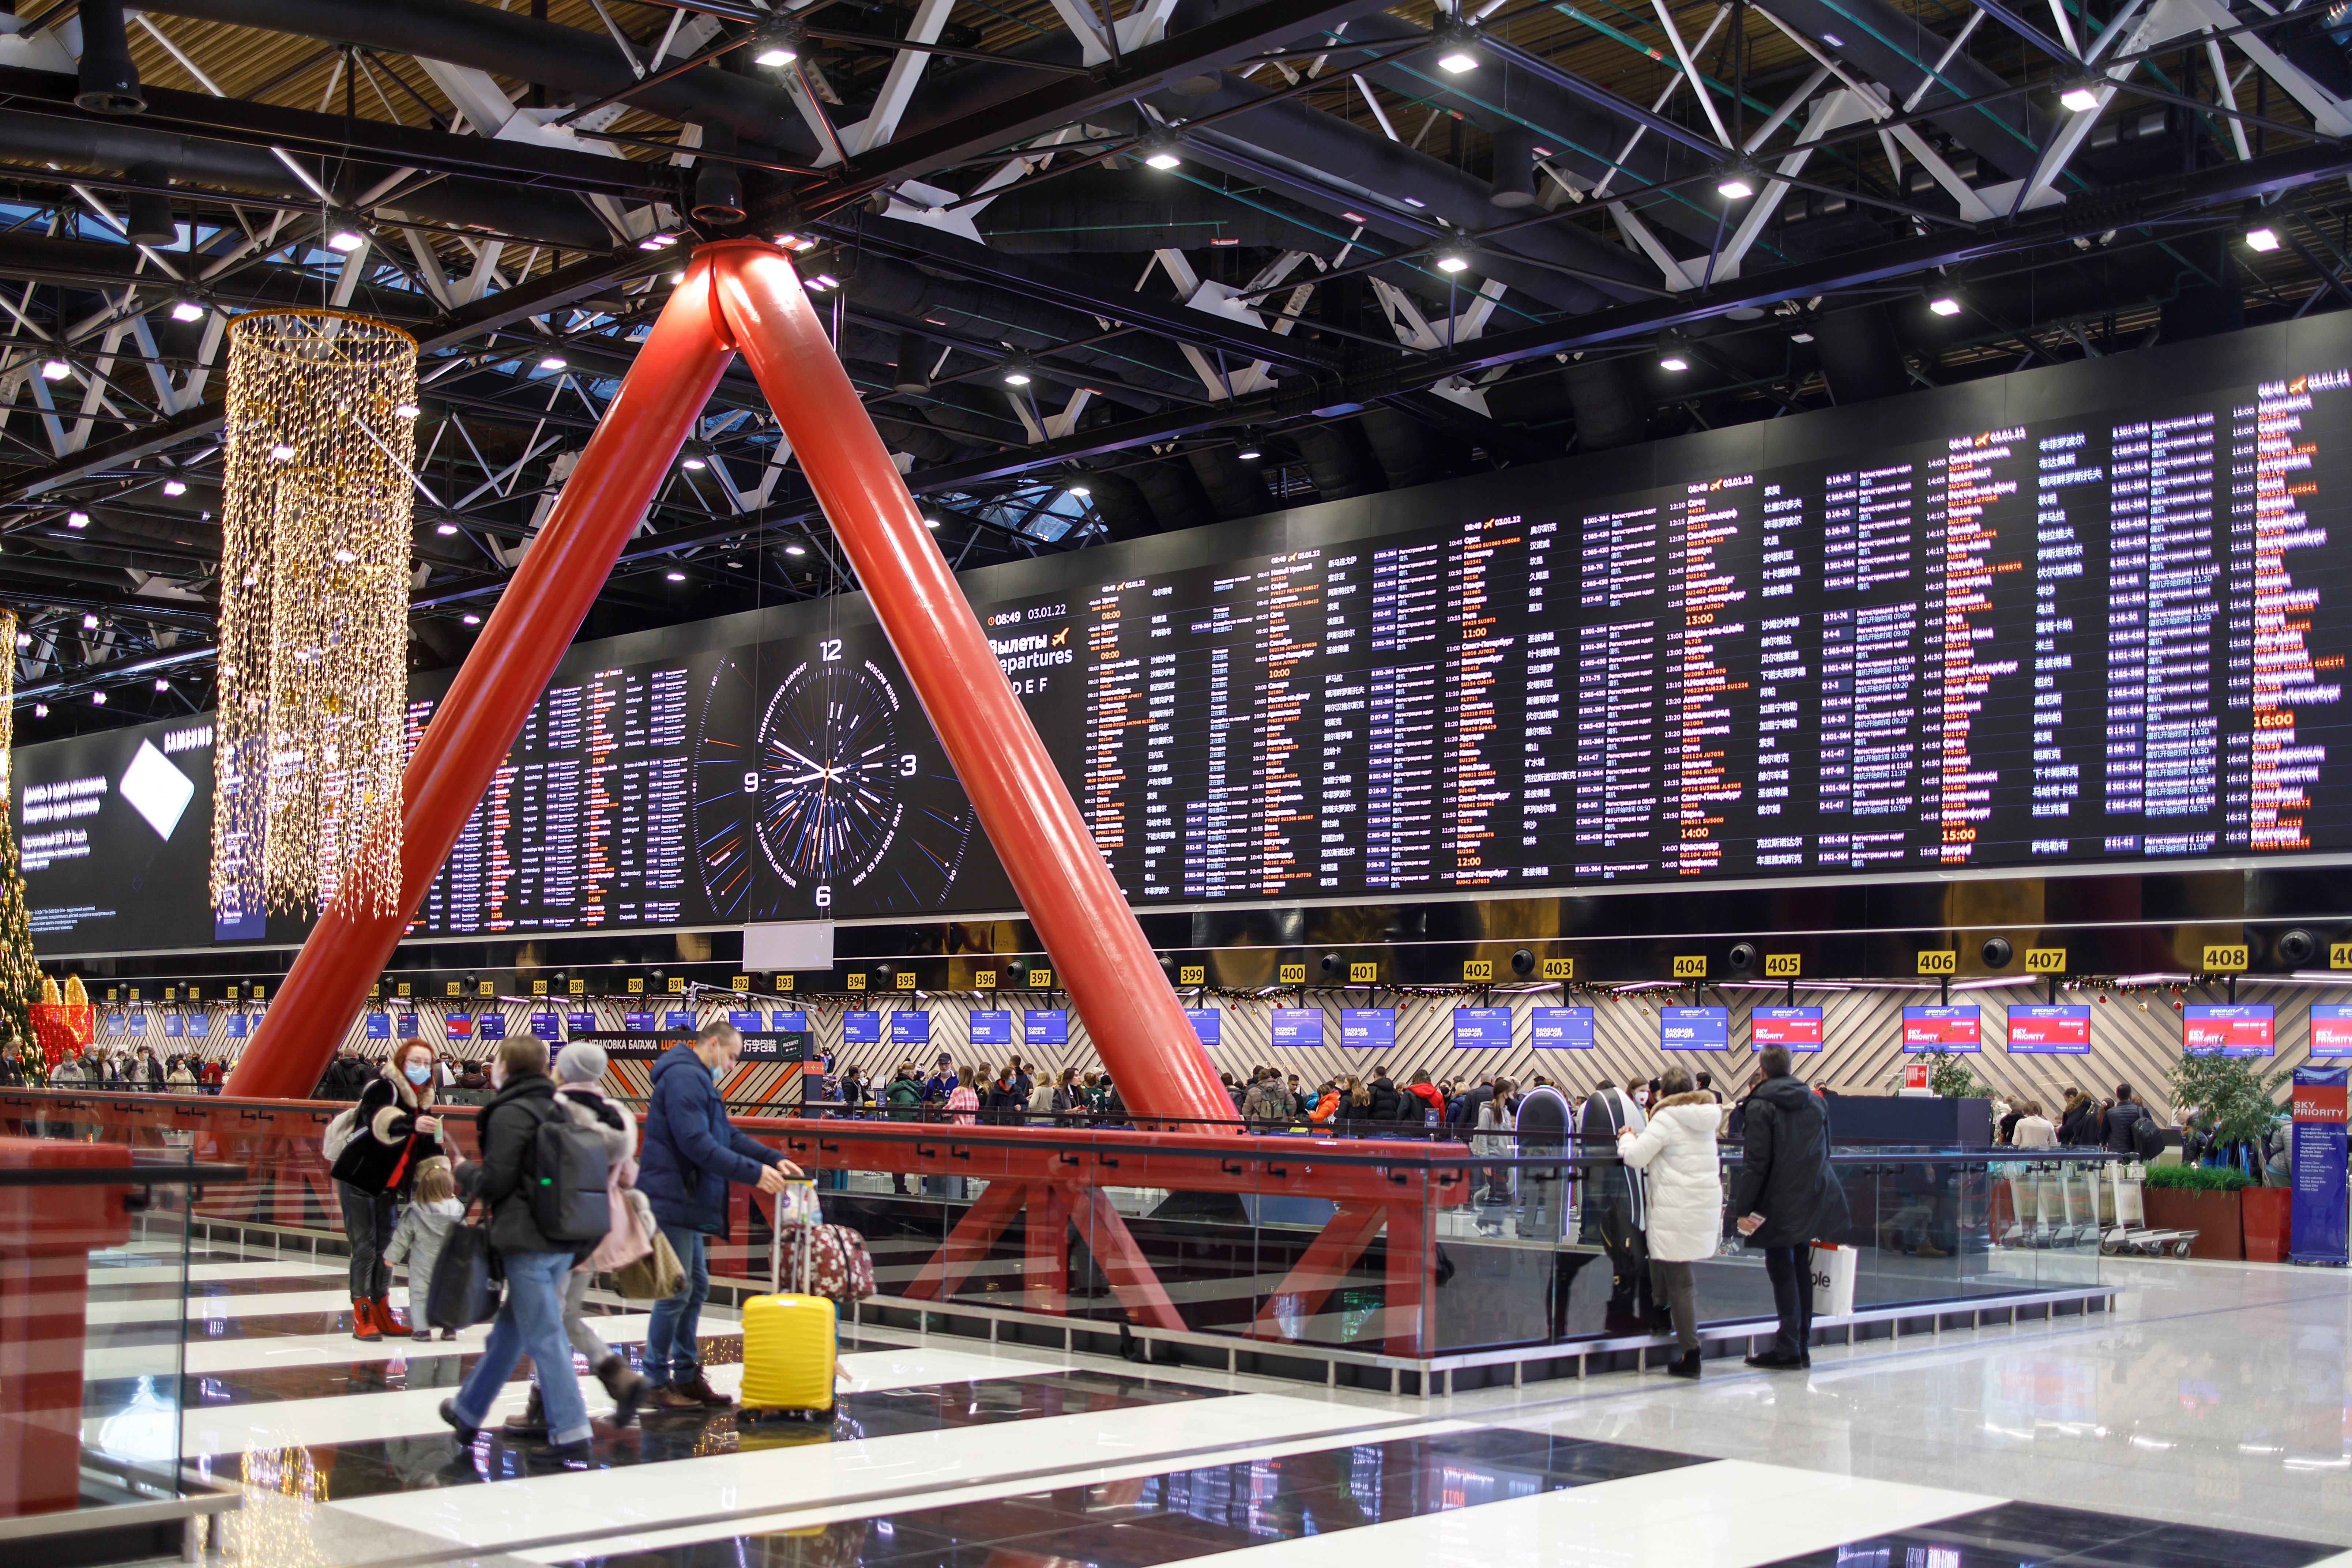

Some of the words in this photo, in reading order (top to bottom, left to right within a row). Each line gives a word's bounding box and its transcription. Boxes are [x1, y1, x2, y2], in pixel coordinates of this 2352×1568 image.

[2258, 381, 2287, 397] 08:49
[2307, 372, 2350, 390] 03.01.22
[2232, 406, 2255, 418] 15:00
[2258, 396, 2312, 413] Мурманск
[2152, 417, 2195, 431] Регистрация
[2196, 414, 2214, 426] идет
[2258, 412, 2286, 421] SU1324
[1948, 437, 1973, 451] 08:49
[1990, 426, 2027, 443] 03.01.22
[2152, 430, 2166, 439] 值机
[2257, 451, 2285, 460] SU1768
[2287, 445, 2316, 456] KL3060
[1927, 458, 1946, 468] 14:00
[1948, 463, 1973, 472] SU1624
[2038, 453, 2076, 470] 布达佩斯
[1722, 475, 1754, 489] 03.01.22
[1669, 501, 1686, 510] 12:10
[1494, 516, 1521, 526] 03.01.22
[1449, 539, 1463, 547] 10:45
[2255, 532, 2327, 549] Екатеринбург
[2255, 548, 2284, 557] SU1404
[1946, 569, 1970, 578] SU2138
[1971, 565, 1996, 575] JU7727
[2036, 584, 2055, 597] 华沙
[995, 611, 1021, 625] 08:49
[1028, 604, 1066, 620] 03.01.22
[1102, 610, 1120, 620] 08:00
[1686, 612, 1714, 627] 13:00
[1463, 627, 1487, 639] 11:00
[820, 639, 842, 662] 12
[988, 634, 1047, 655] Вылеты
[1001, 648, 1073, 675] epartures
[1100, 651, 1119, 660] 09:00
[1269, 668, 1290, 678] 10:00
[865, 660, 888, 685] MOSCOW
[885, 683, 899, 711] RUSSIA
[1026, 679, 1034, 694] E
[1039, 677, 1048, 692] F
[757, 685, 785, 743] SHEREMETYEVO
[785, 662, 807, 687] AIRPORT
[2253, 713, 2293, 728] 16:00
[164, 725, 213, 754] SAMSUNG
[901, 754, 917, 776] 3
[744, 772, 759, 792] 9
[72, 831, 87, 841] Touch
[1681, 827, 1709, 839] 14:00
[1942, 828, 1976, 841] 15:00
[2225, 832, 2247, 841] 16:30
[2250, 828, 2300, 842] Белгород
[853, 871, 866, 886] MON
[867, 862, 875, 872] 03
[874, 849, 884, 864] JAN
[882, 830, 895, 851] 2022
[892, 803, 903, 827] 08:49
[2031, 840, 2068, 853] 萨格勒布
[2280, 838, 2310, 847] SU6255
[759, 832, 774, 861] FLIGHTS
[771, 859, 784, 875] LAST
[782, 872, 797, 888] HOUR
[1457, 857, 1481, 867] 12:00
[949, 870, 956, 881] 20
[705, 885, 711, 896] 40
[816, 886, 831, 906] 6
[1920, 955, 1953, 969] 406
[2028, 953, 2062, 968] 407
[2207, 950, 2244, 965] 408
[2334, 949, 2352, 964] 40
[1465, 964, 1490, 976] 402
[1545, 962, 1570, 975] 403
[1676, 960, 1704, 973] 404
[1768, 958, 1797, 972] 405
[1032, 973, 1049, 983] 397
[1183, 969, 1202, 980] 399
[1282, 968, 1303, 979] 400
[1352, 966, 1373, 978] 401
[670, 980, 682, 990] 391
[734, 979, 747, 988] 392
[778, 978, 791, 987] 393
[849, 977, 864, 986] 394
[899, 976, 914, 986] 395
[978, 974, 994, 984] 396
[400, 985, 409, 994] 385
[482, 984, 492, 992] 387
[535, 983, 545, 991] 388
[571, 982, 582, 991] 389
[630, 981, 641, 990] 390
[629, 1040, 657, 1050] БАГАЖА
[783, 1039, 799, 1048] PACK&FLY
